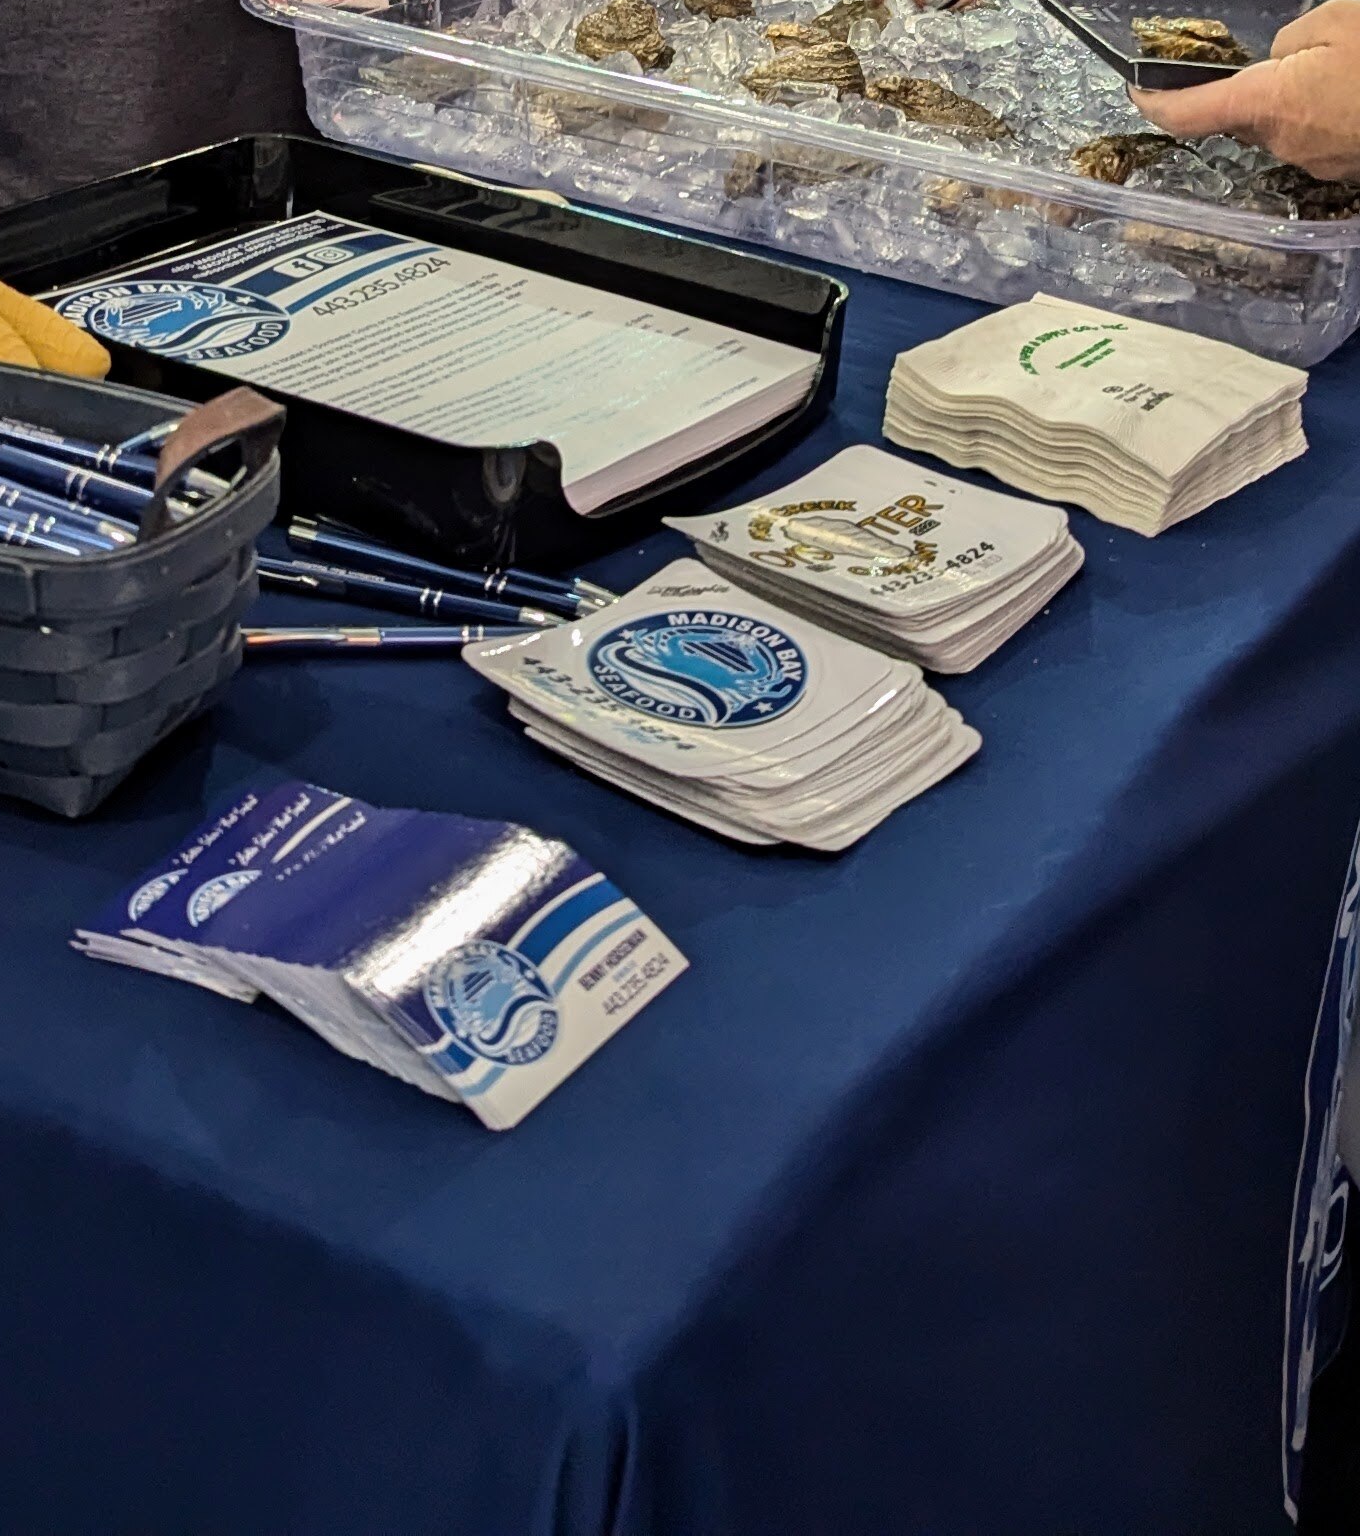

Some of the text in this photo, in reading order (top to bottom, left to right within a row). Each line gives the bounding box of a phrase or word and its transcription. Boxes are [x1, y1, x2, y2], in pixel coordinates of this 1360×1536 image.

[312, 257, 450, 318] 443.235.4824
[186, 319, 285, 362] SEAFOOD
[855, 494, 944, 536] TER
[667, 612, 804, 683] MADISON BAY
[594, 663, 698, 721] SEAFOOD
